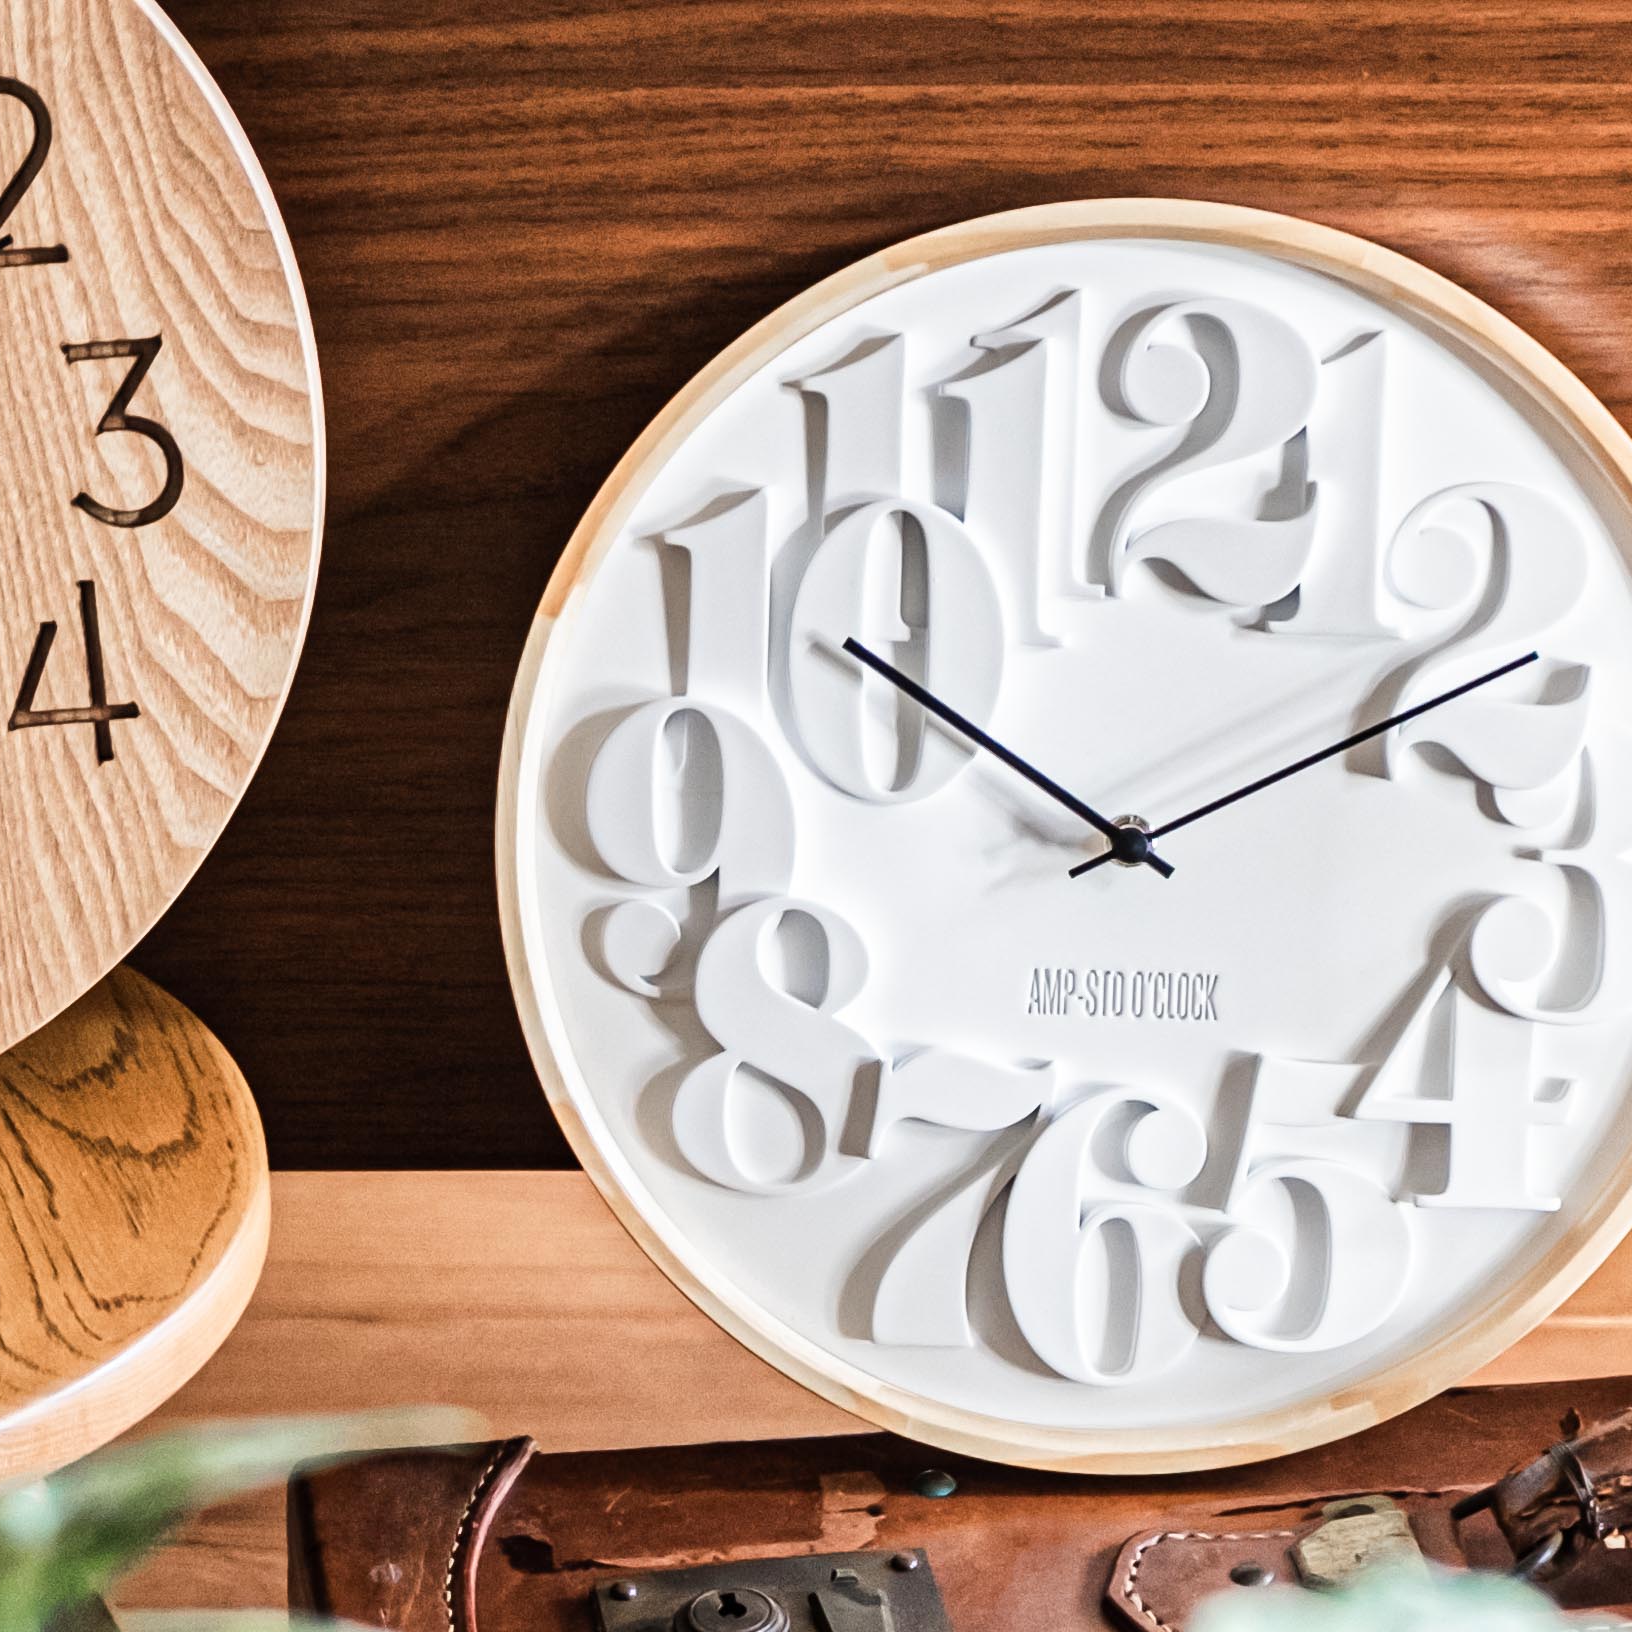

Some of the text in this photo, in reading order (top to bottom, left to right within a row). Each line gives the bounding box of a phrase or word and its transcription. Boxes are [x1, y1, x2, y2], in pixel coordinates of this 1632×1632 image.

[60, 335, 183, 528] 3
[785, 332, 1070, 648] 11
[970, 287, 1318, 607] 12
[1261, 329, 1413, 640] 1
[6, 578, 140, 764] 4
[635, 486, 1004, 800] 10
[1381, 480, 1590, 790] 2
[585, 693, 795, 997] 9
[1027, 967, 1219, 1021] AMP-STD O'CLOCK
[672, 895, 869, 1194] 8
[1339, 965, 1577, 1211] 4
[868, 1053, 1054, 1348] 7
[1002, 1083, 1204, 1384] 6
[1201, 1050, 1411, 1351] 5
